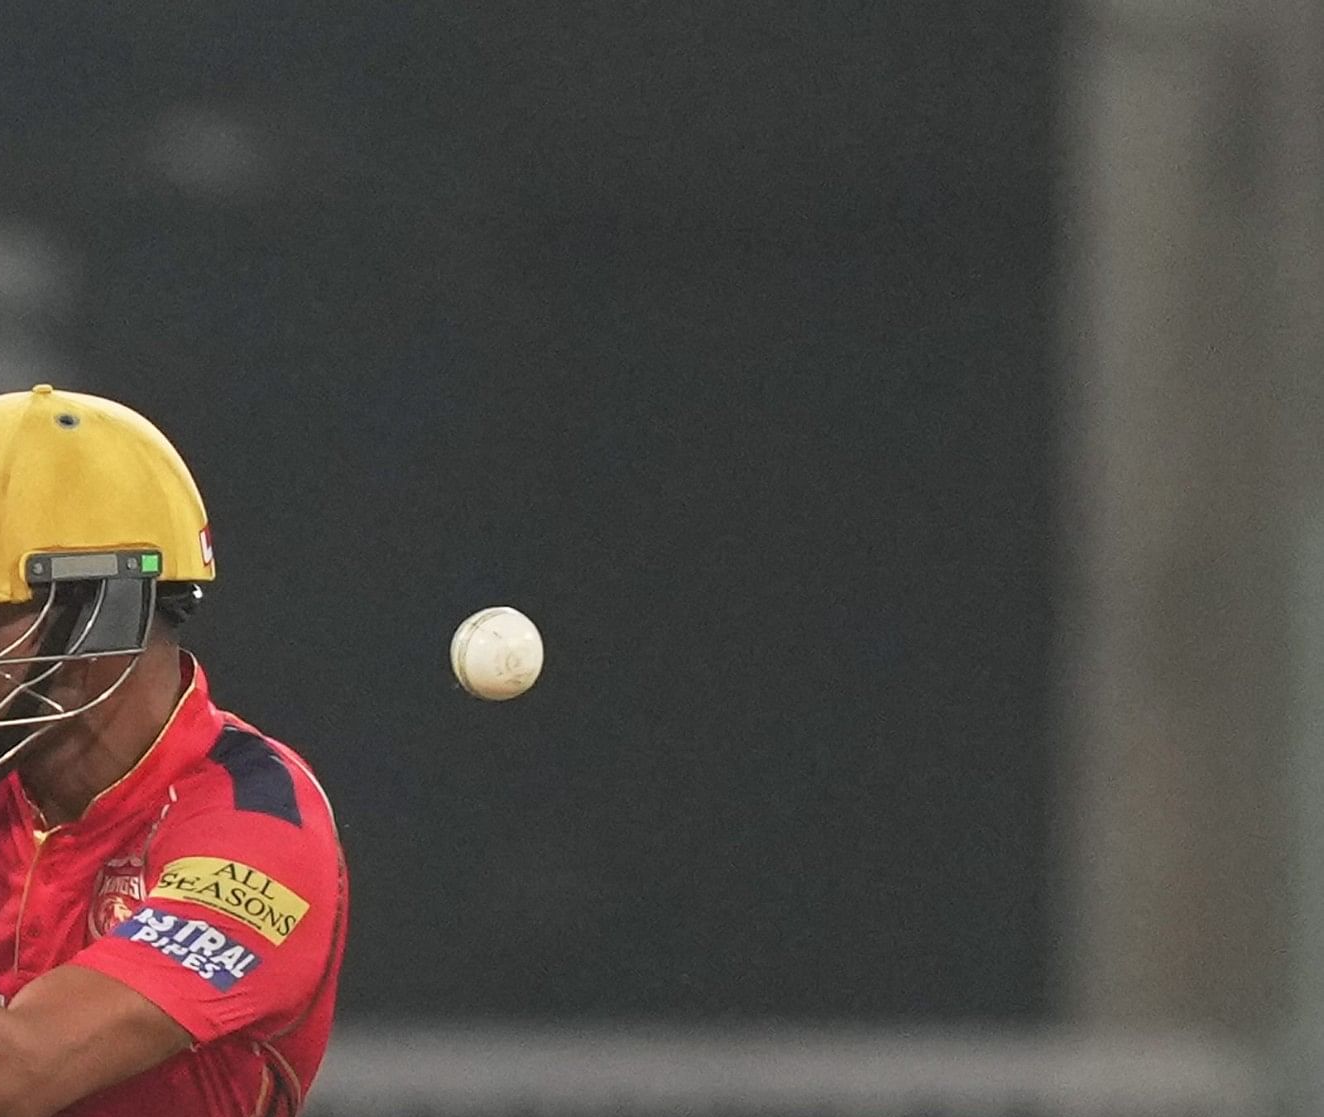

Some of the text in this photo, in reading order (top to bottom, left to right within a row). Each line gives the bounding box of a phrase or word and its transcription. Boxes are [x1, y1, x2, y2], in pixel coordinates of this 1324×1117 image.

[157, 872, 297, 937] SEASONS
[213, 862, 275, 900] ALL
[133, 907, 255, 979] ASTRAL
